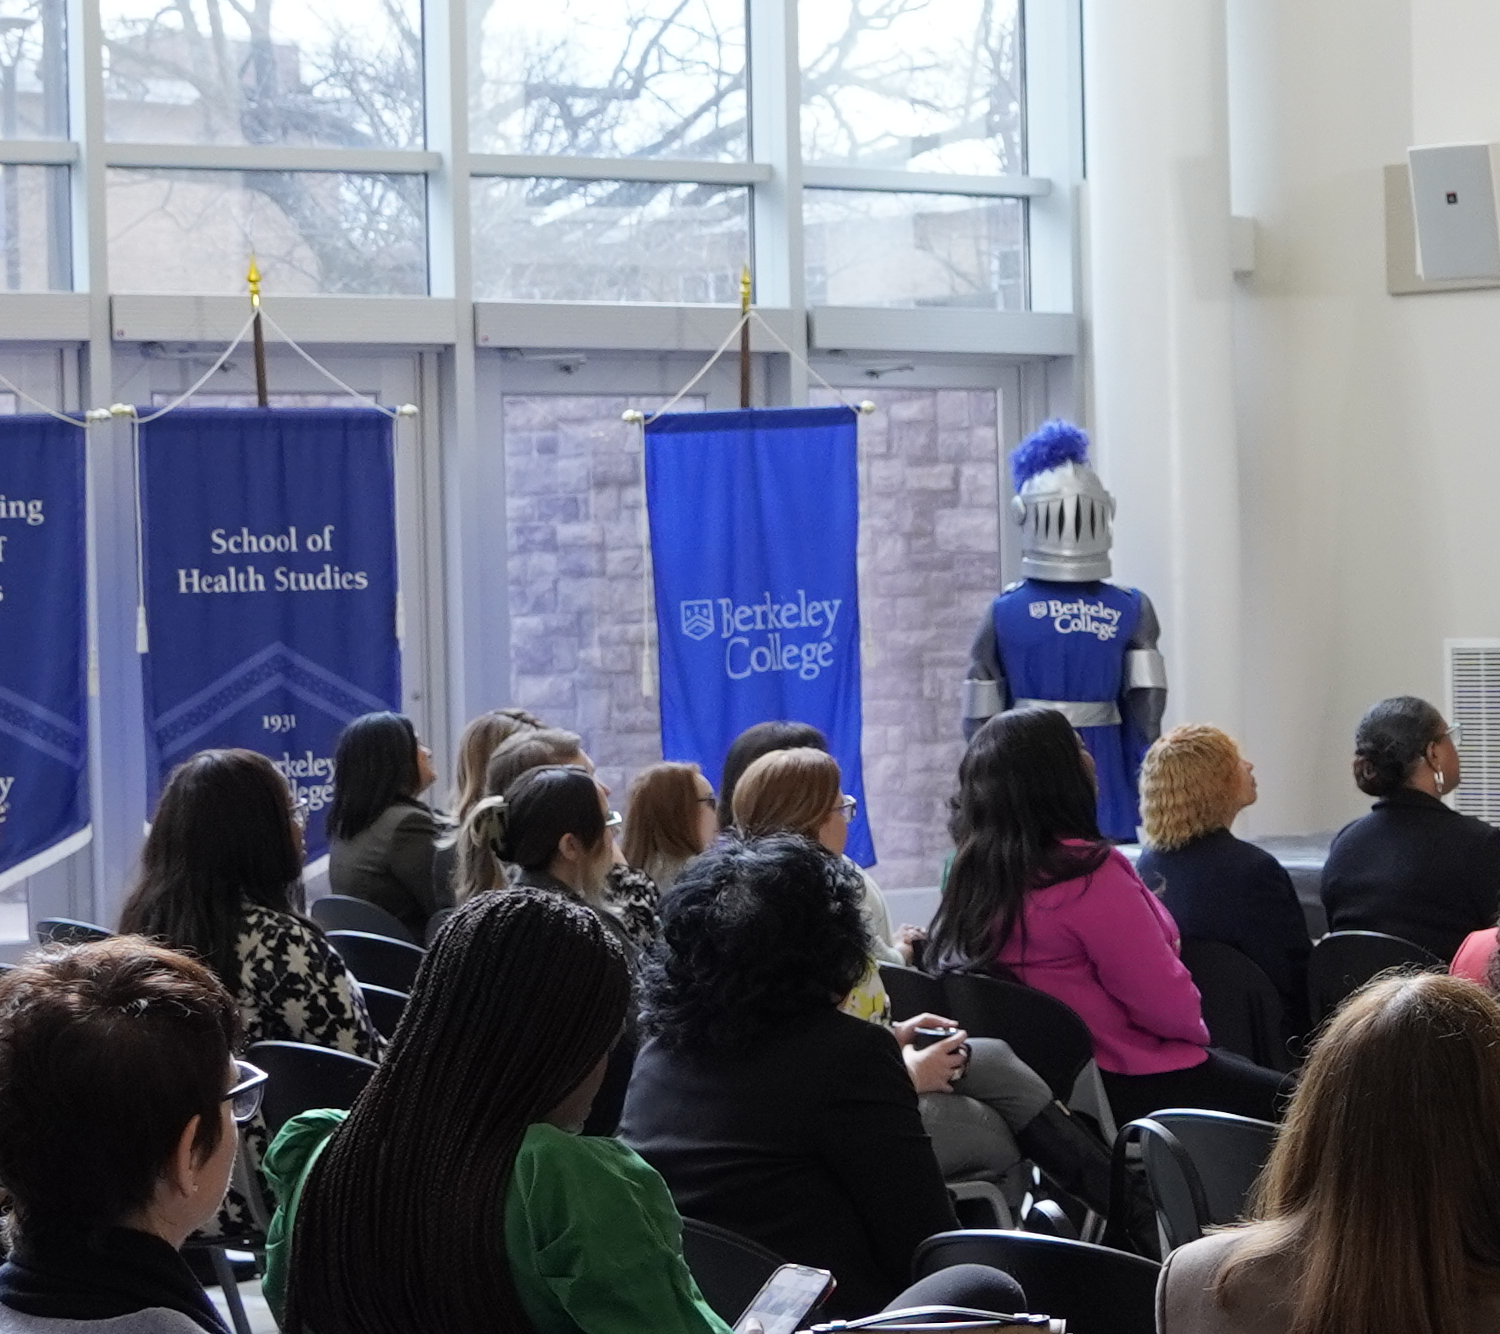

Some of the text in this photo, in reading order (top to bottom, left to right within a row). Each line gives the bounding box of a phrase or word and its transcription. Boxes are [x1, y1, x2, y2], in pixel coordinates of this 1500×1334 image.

[211, 524, 335, 554] School of
[178, 564, 369, 593] Health Studies
[717, 589, 842, 639] Berkeley
[1048, 598, 1122, 626] Berkeley
[1054, 614, 1119, 641] College
[726, 633, 834, 680] College
[262, 713, 297, 733] 1931
[273, 750, 336, 784] keley
